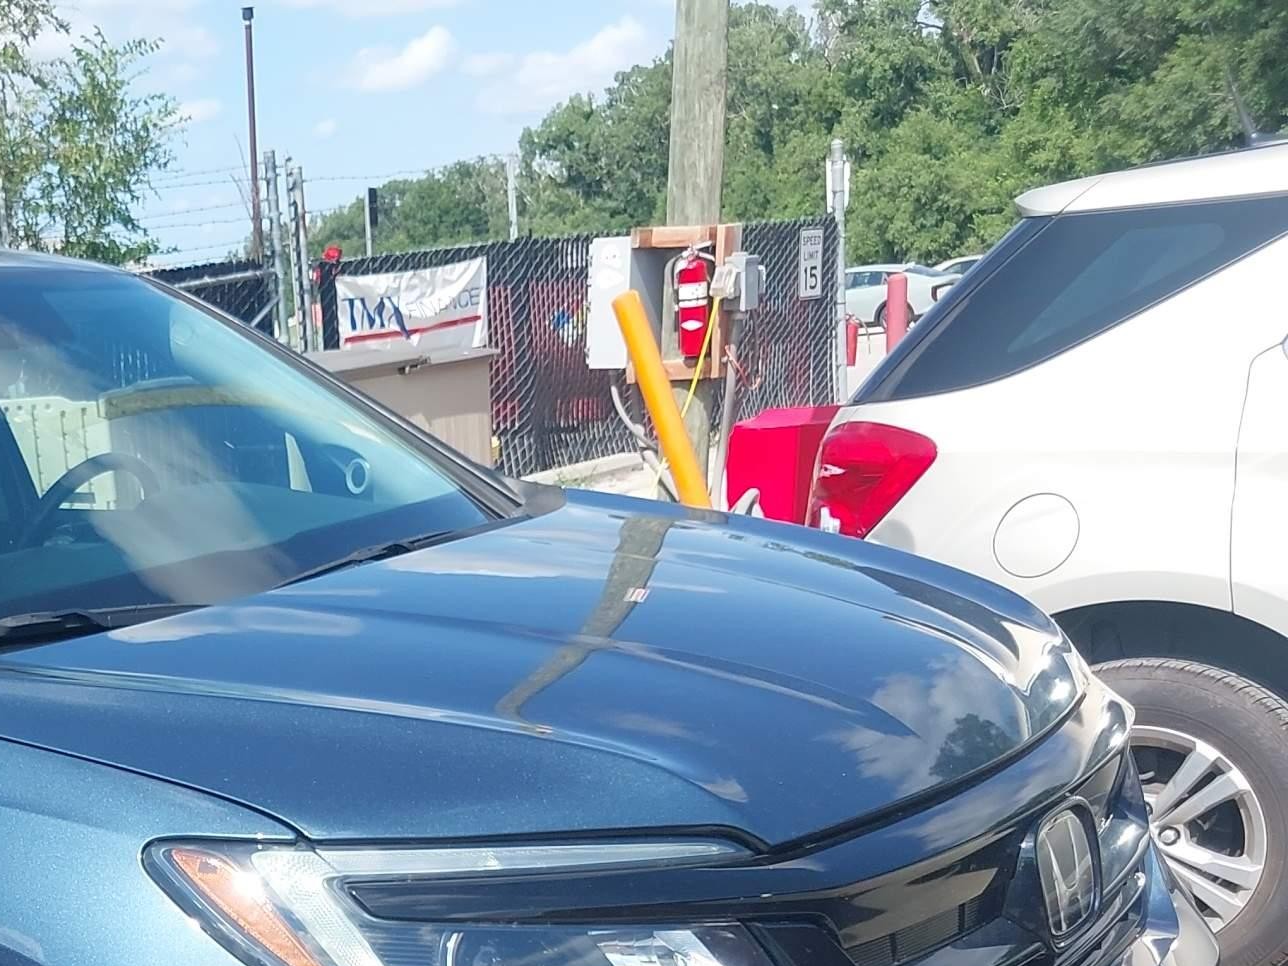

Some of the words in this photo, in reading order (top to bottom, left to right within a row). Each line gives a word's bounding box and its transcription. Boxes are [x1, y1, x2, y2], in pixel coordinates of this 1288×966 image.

[802, 235, 822, 246] SPEED
[803, 250, 820, 261] LIMIT
[803, 265, 818, 292] 15
[340, 296, 411, 340] TMX
